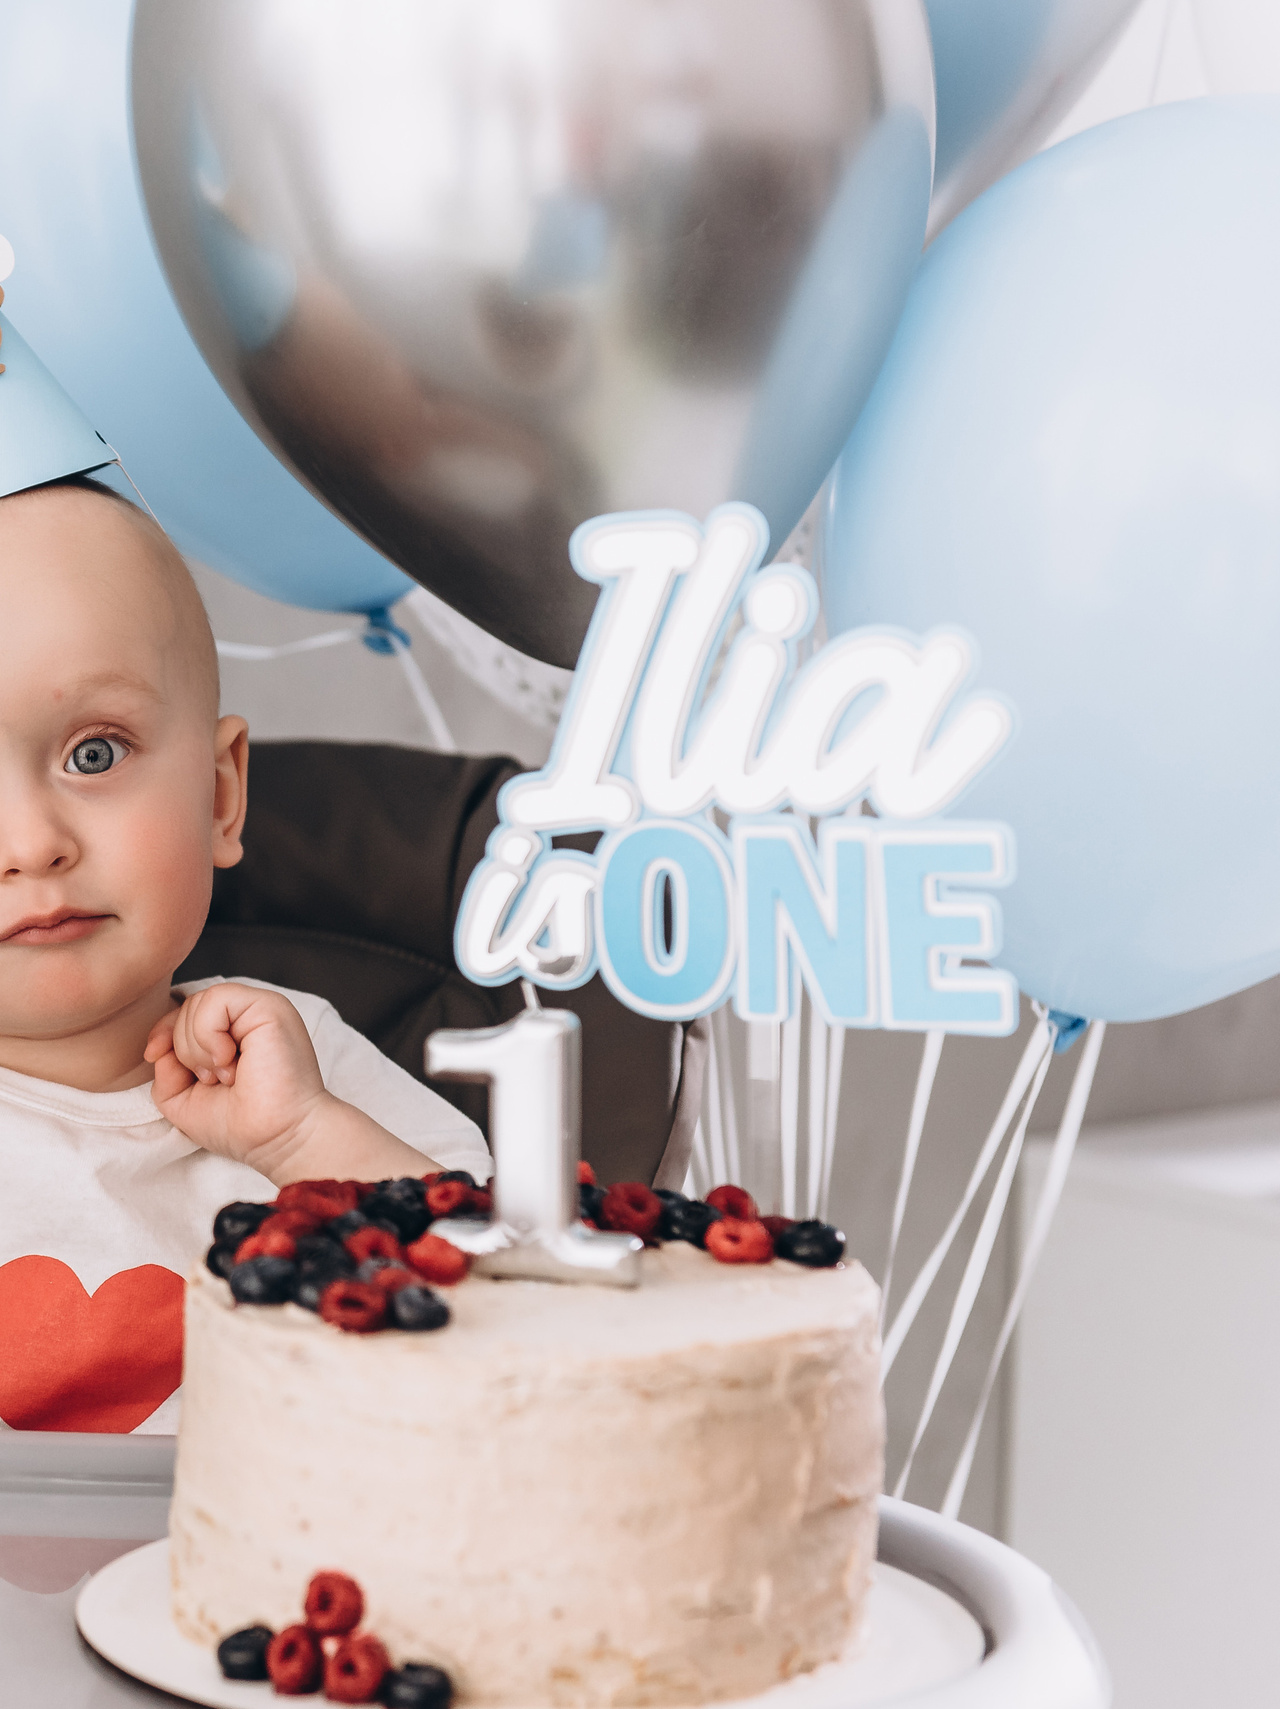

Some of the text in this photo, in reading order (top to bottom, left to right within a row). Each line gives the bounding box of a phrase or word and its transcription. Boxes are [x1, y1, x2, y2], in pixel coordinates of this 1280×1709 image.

[499, 503, 1015, 819] Ilia
[455, 821, 1017, 1034] is ONE
[424, 1007, 644, 1288] 1
